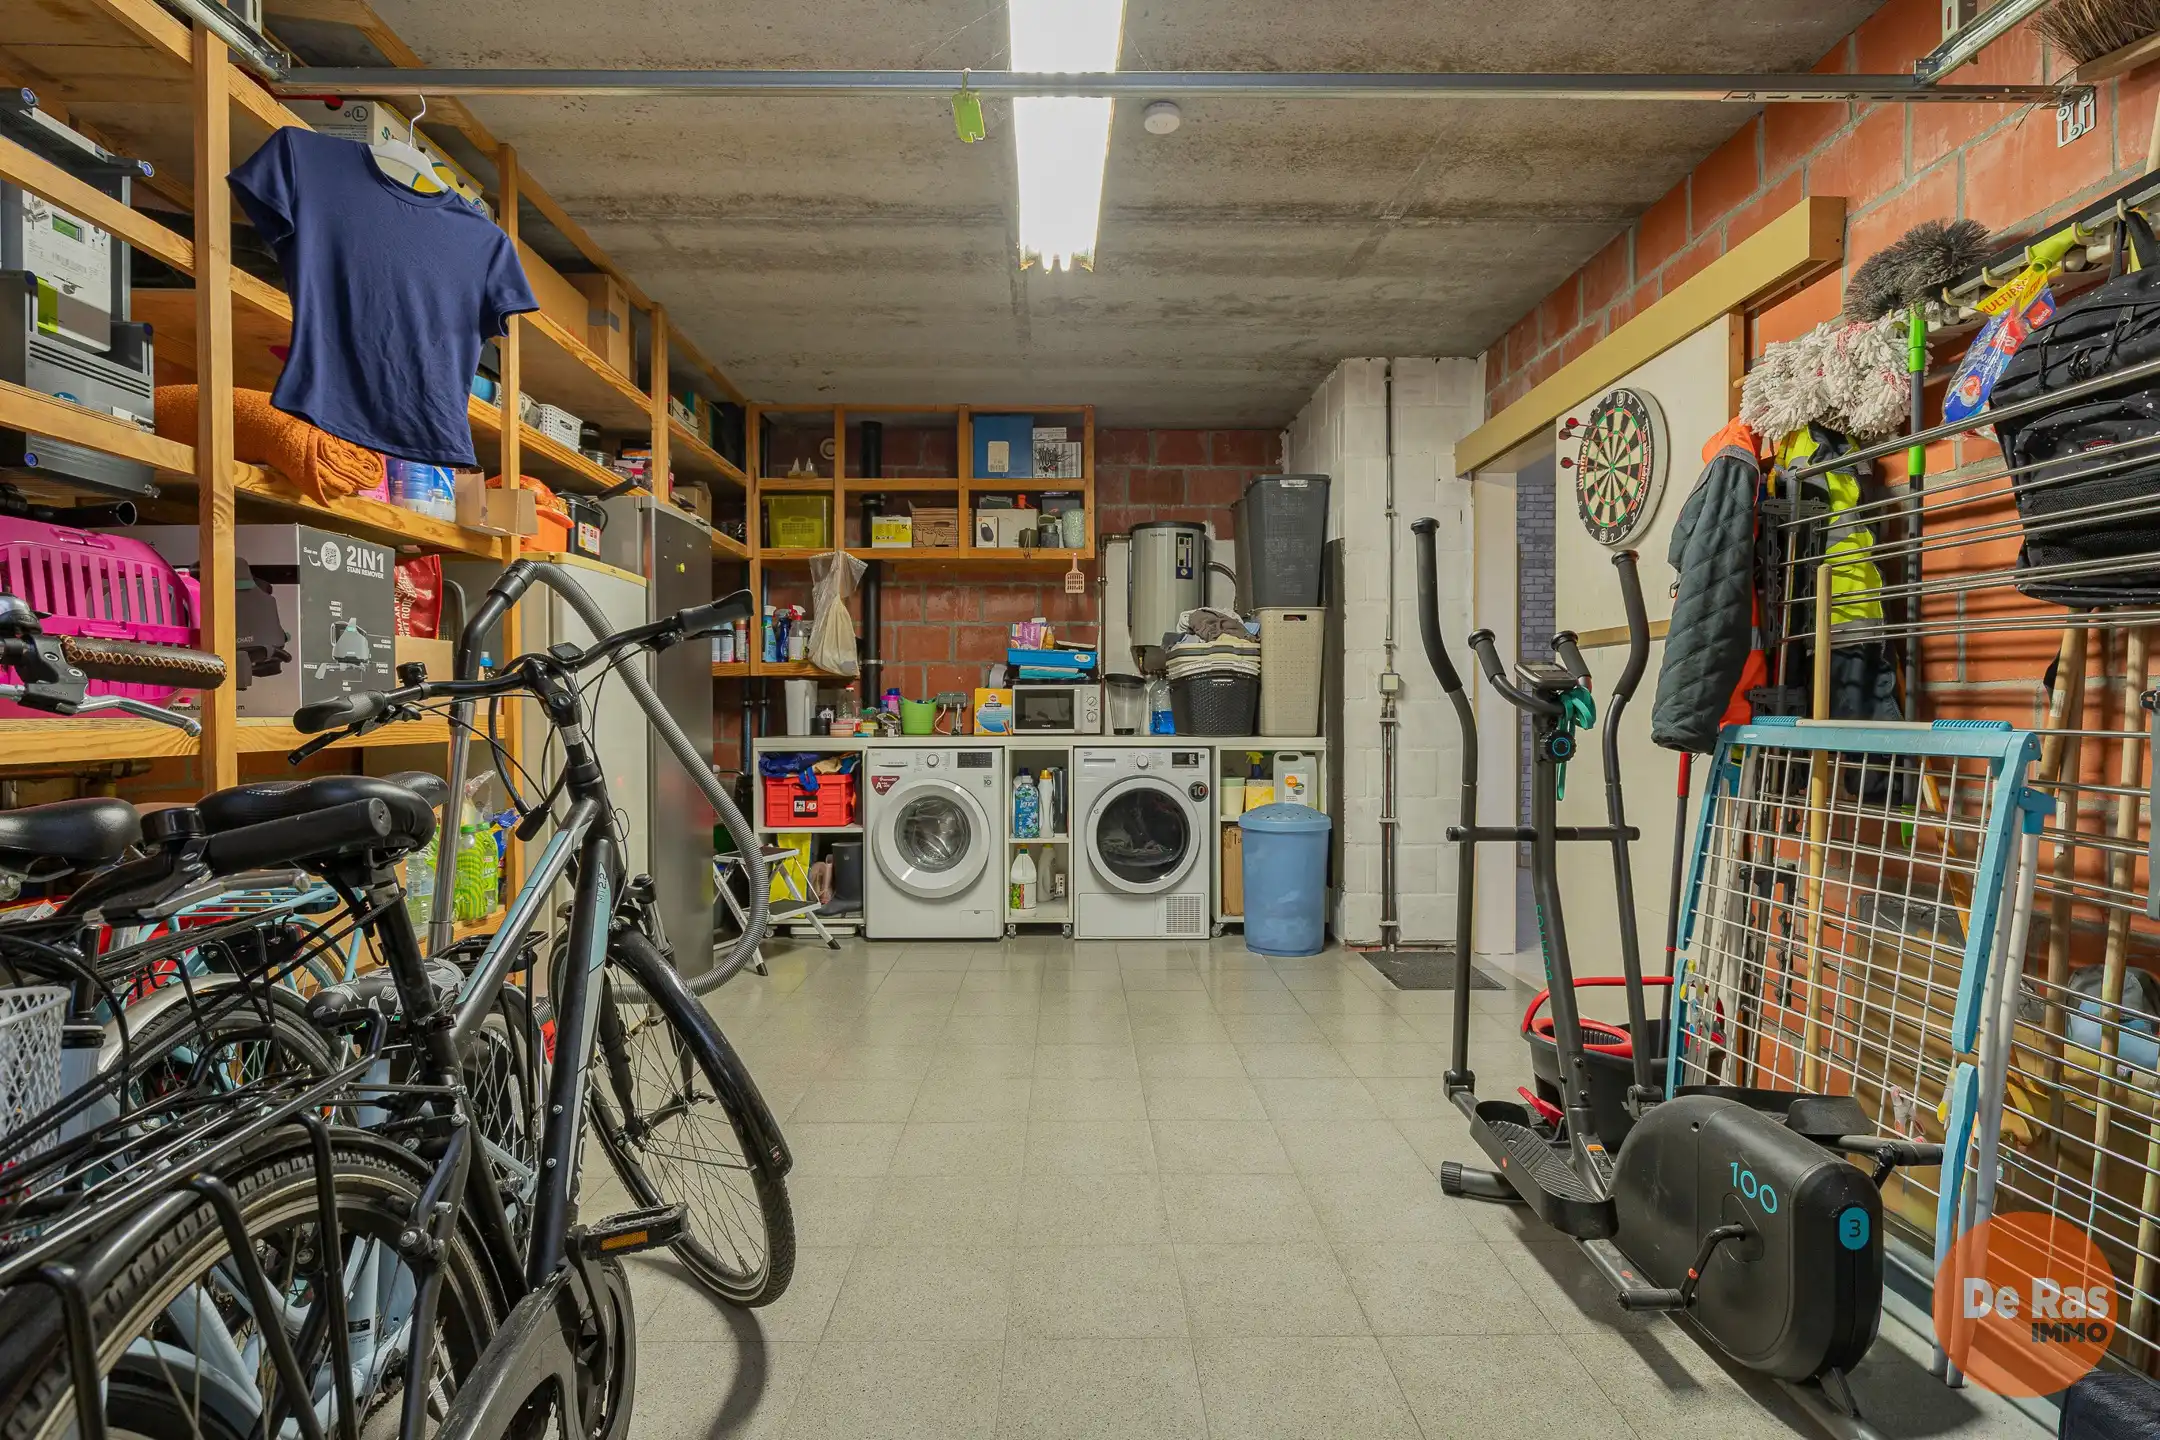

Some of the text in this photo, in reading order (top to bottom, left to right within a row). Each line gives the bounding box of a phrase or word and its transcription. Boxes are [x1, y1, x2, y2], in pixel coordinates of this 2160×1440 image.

[346, 545, 384, 573] 2IN1
[346, 565, 384, 580] STAIN REMOVER
[401, 596, 416, 619] RODE
[1192, 785, 1205, 796] 10
[1730, 1162, 1778, 1214] 100
[1849, 1219, 1861, 1237] 3
